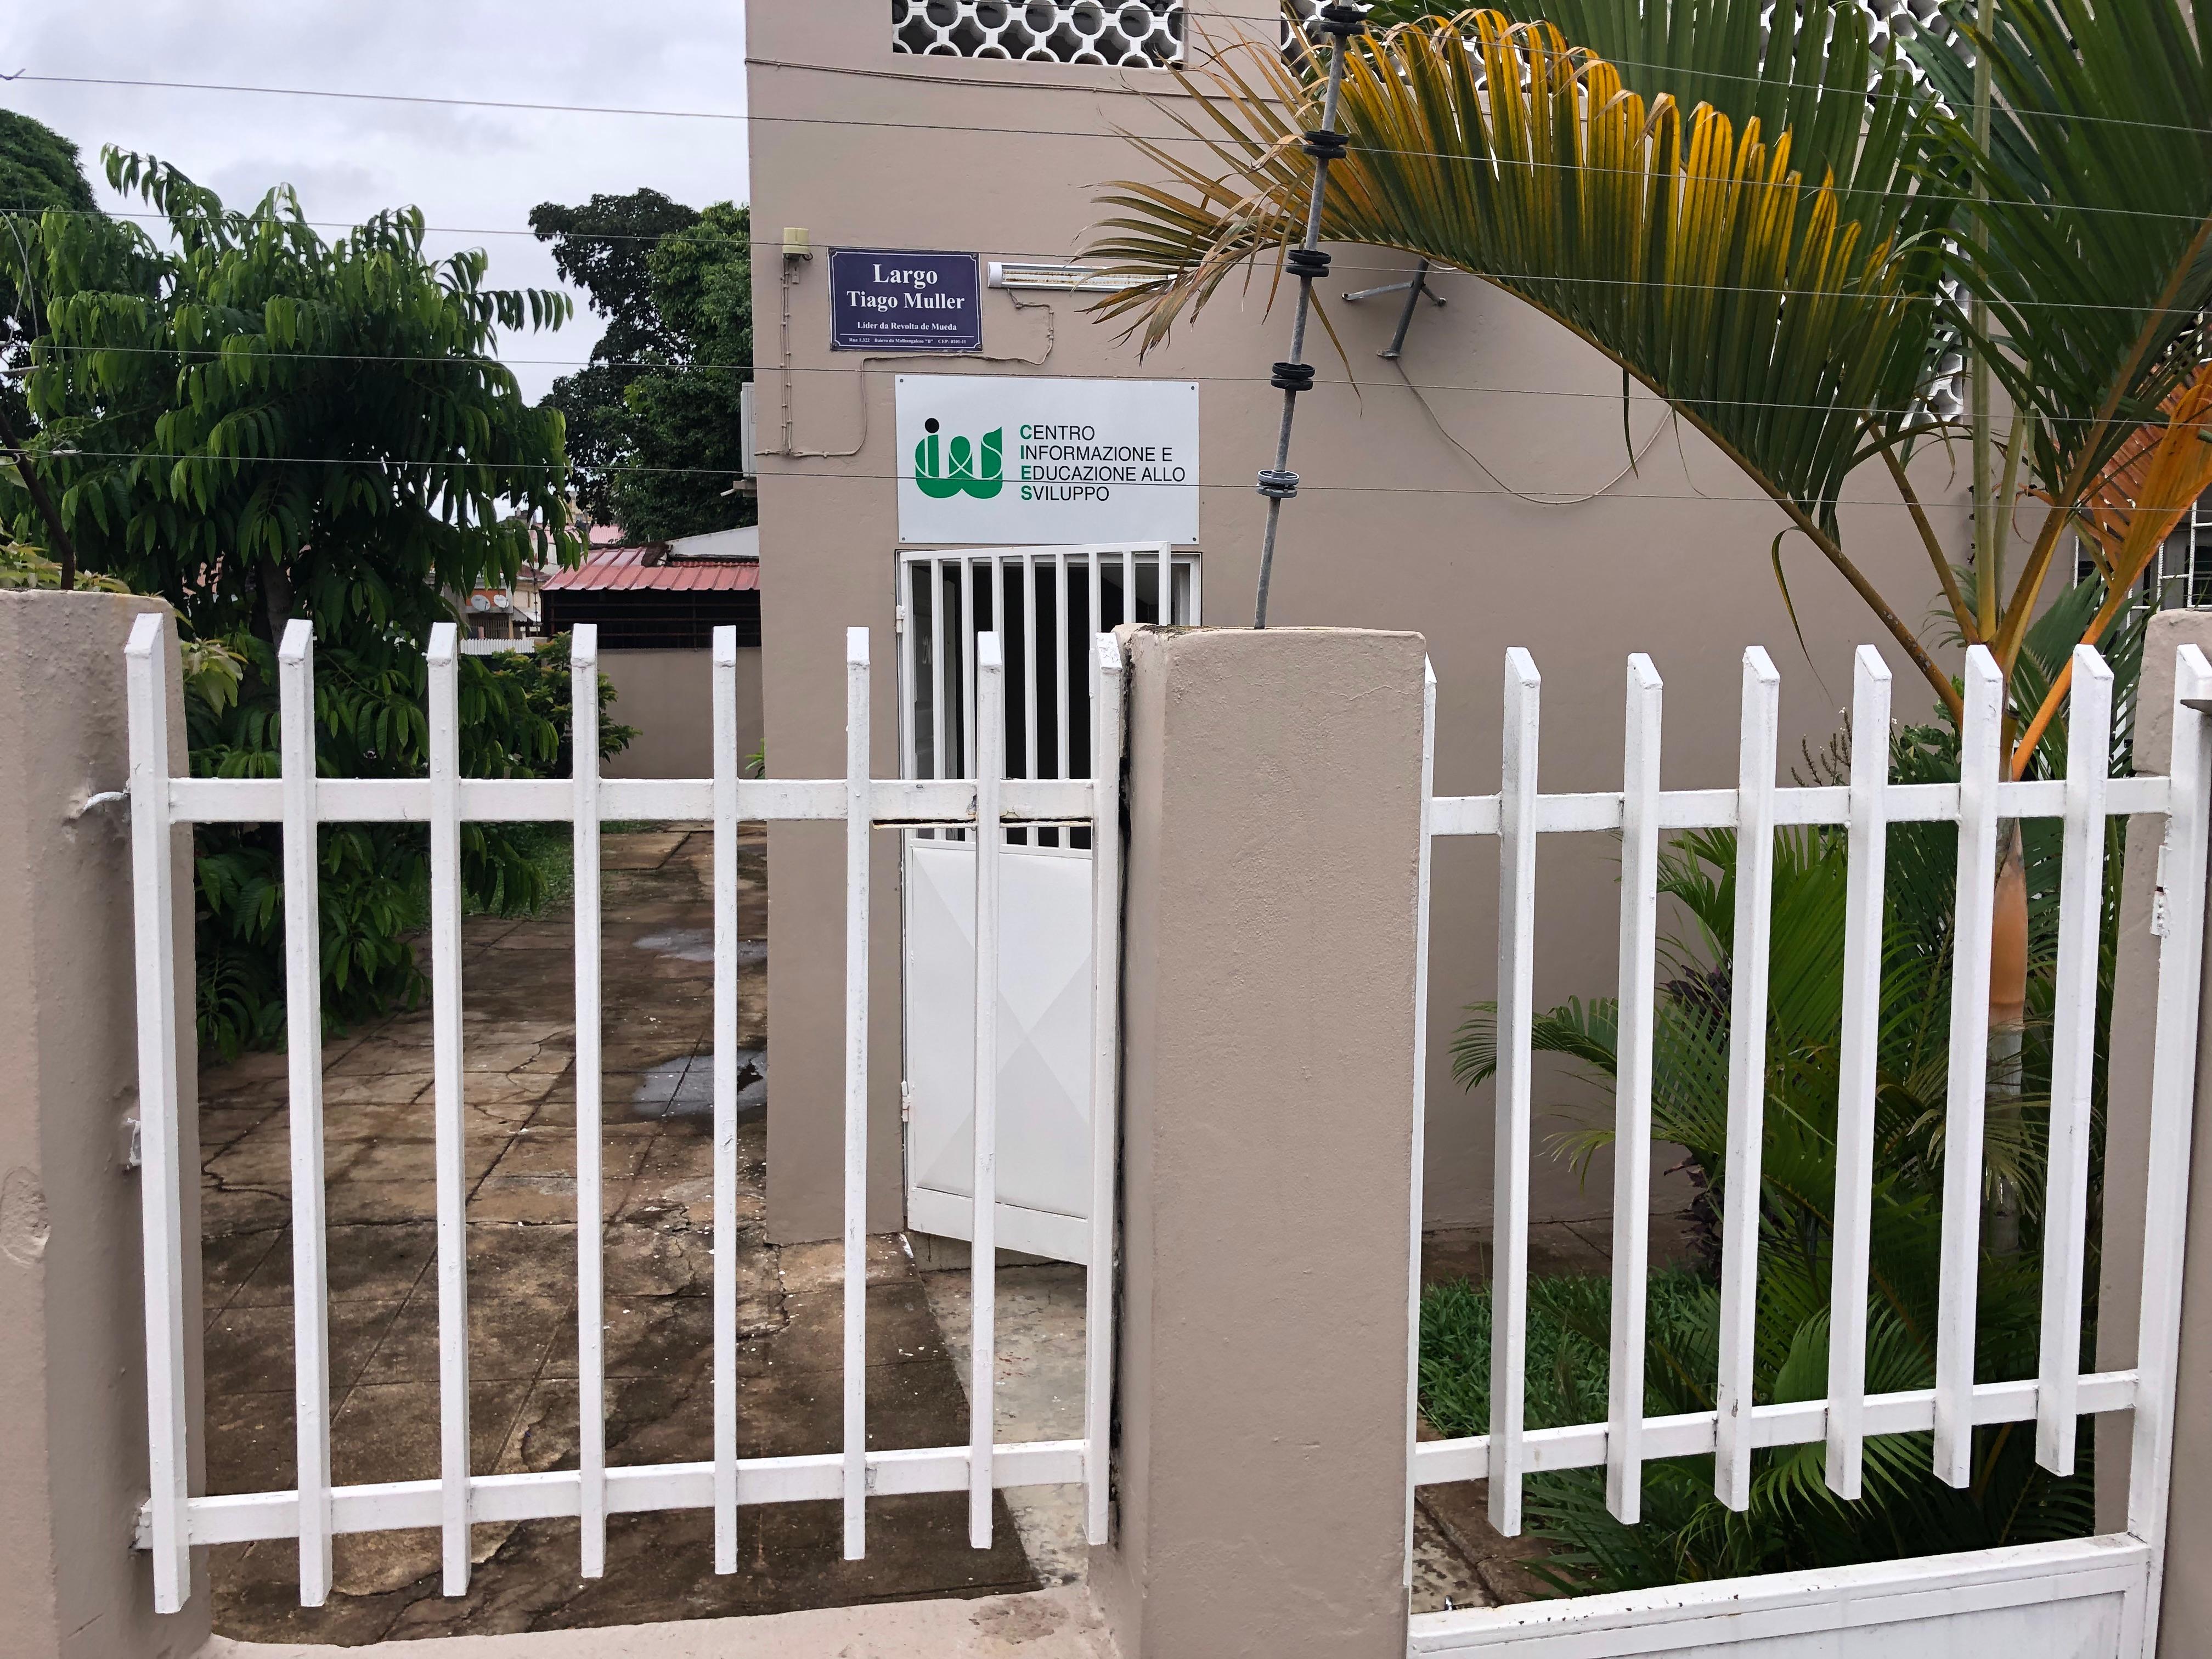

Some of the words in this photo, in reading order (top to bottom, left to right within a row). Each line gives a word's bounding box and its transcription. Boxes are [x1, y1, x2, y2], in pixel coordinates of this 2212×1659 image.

[873, 264, 938, 289] Largo
[847, 291, 898, 312] Tiago
[903, 292, 965, 309] Muller
[1020, 425, 1095, 441] CENTRO
[1021, 445, 1155, 462] INFORMAZIONE
[1163, 447, 1172, 462] E
[1022, 466, 1136, 481] EDUCAZIONE
[1141, 467, 1186, 482] ALLO
[1021, 486, 1109, 501] SVILUPPO
